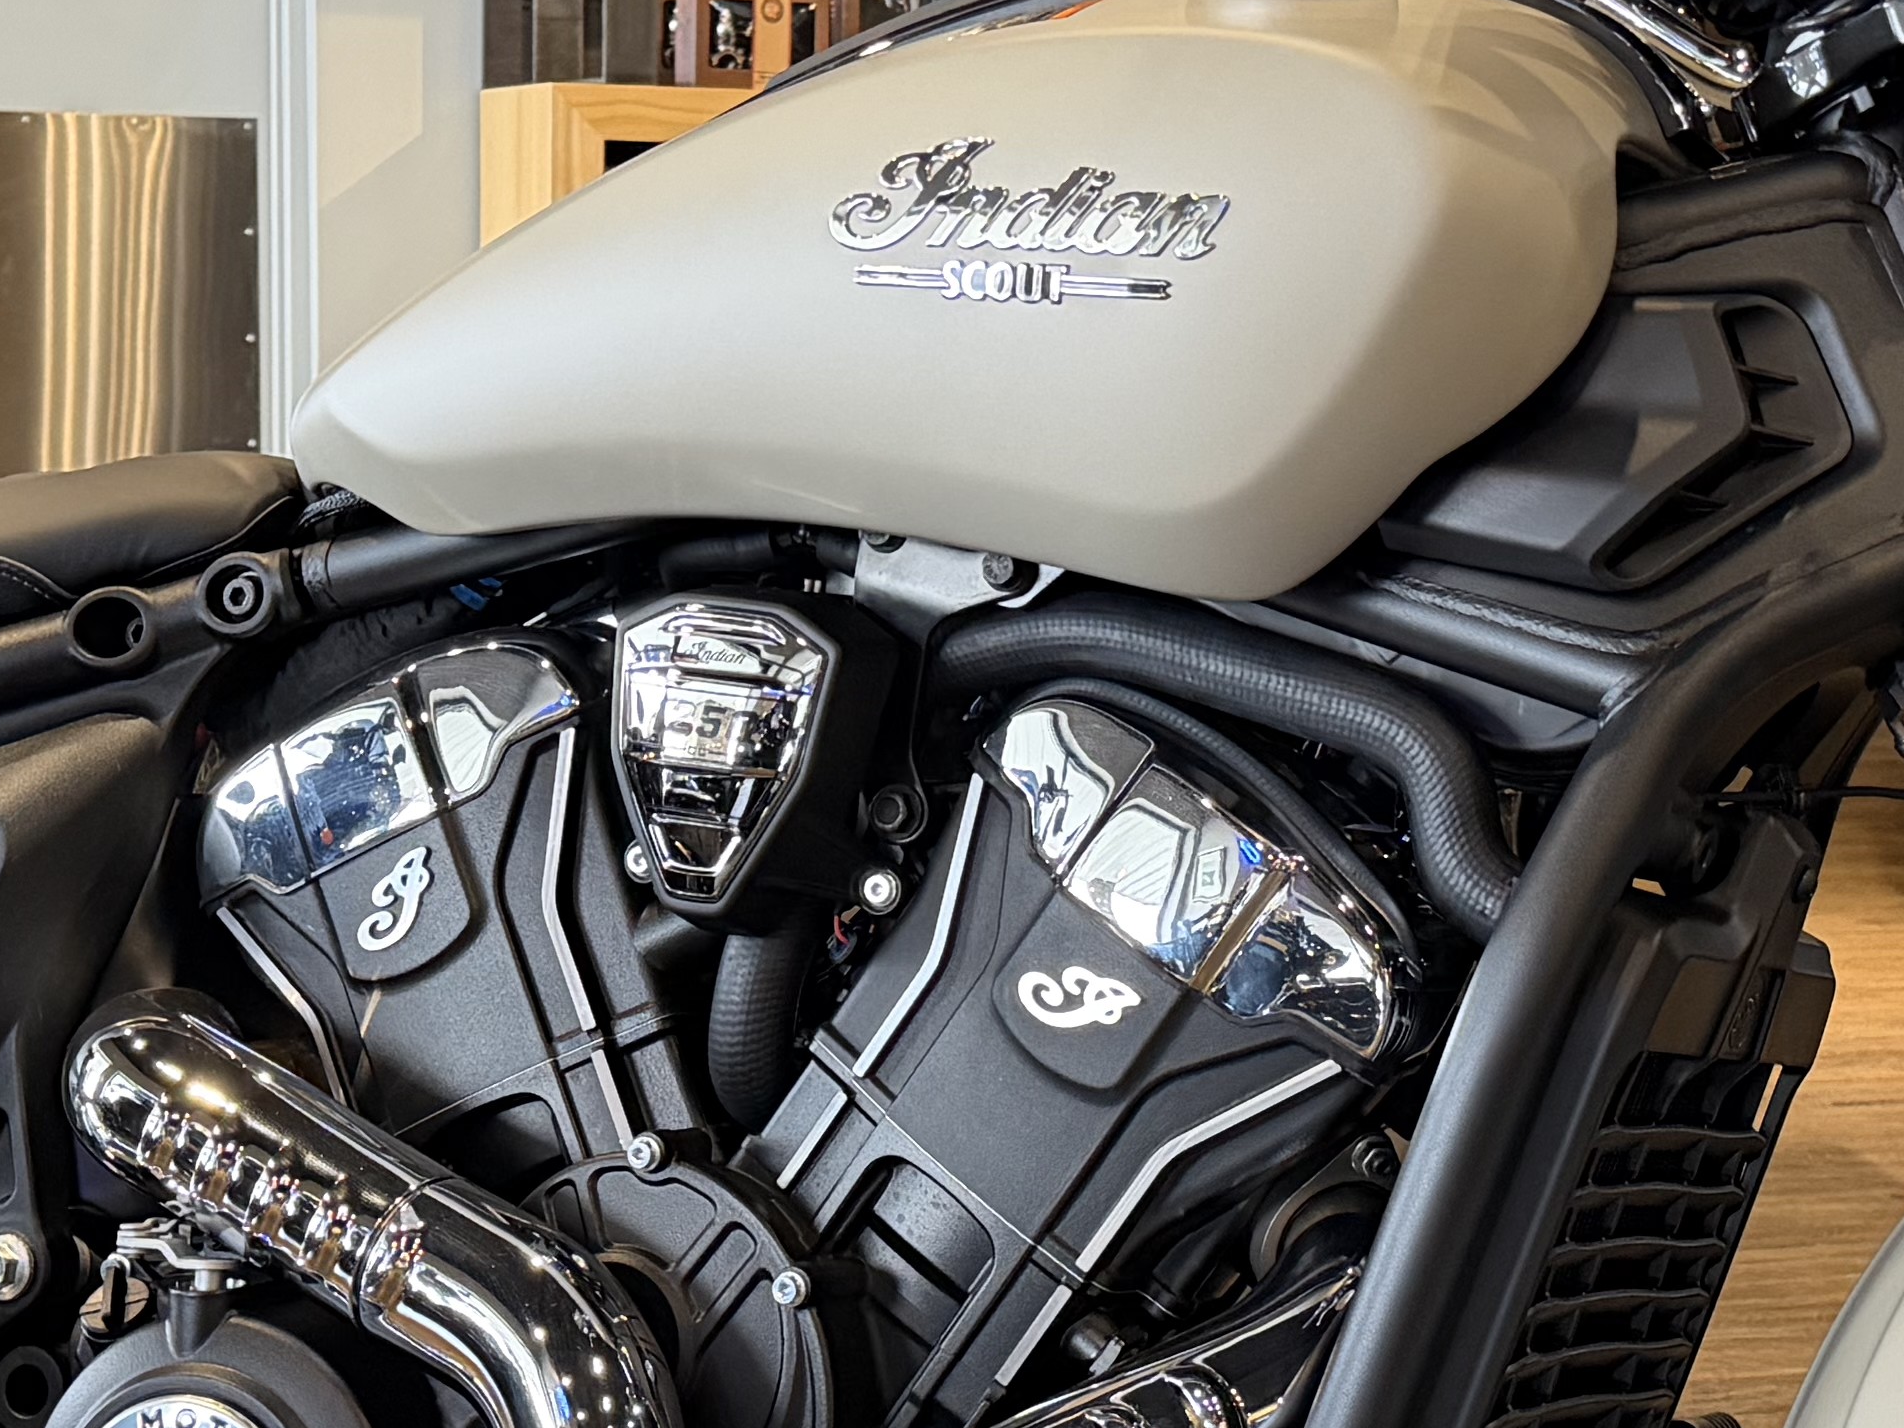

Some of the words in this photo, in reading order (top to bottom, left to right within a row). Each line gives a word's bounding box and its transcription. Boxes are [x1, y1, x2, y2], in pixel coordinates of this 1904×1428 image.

[827, 135, 1231, 261] Indian
[939, 259, 1071, 304] SCOUT
[683, 640, 747, 666] Indian
